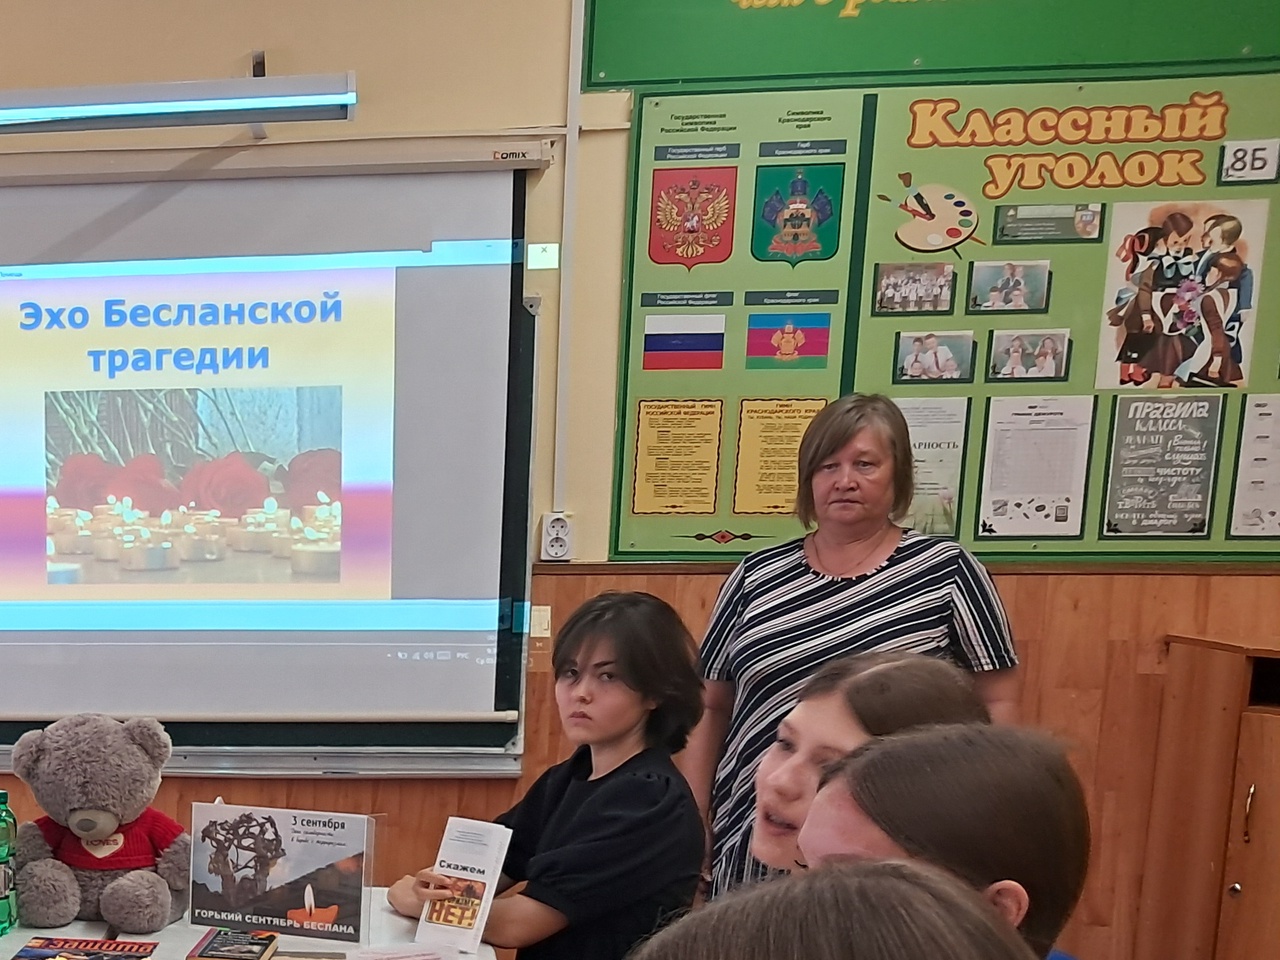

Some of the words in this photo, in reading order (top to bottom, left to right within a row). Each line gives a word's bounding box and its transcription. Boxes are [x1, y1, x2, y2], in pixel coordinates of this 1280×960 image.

[906, 91, 1229, 148] Классный
[1231, 148, 1268, 171] 8Б
[982, 150, 1206, 199] уголок
[19, 301, 90, 330] Эхо
[104, 291, 343, 327] Бесланской
[87, 346, 270, 379] трагедии
[912, 441, 959, 450] АРНОСТЬ
[291, 815, 298, 826] 3
[301, 817, 346, 832] сентября
[439, 859, 486, 875] Скажем
[194, 908, 242, 922] ГОРЬКИЙ
[245, 914, 300, 928] СЕНТЯБРЬ
[303, 920, 355, 935] БЕСЛАНА
[427, 901, 477, 927] НЕТ!
